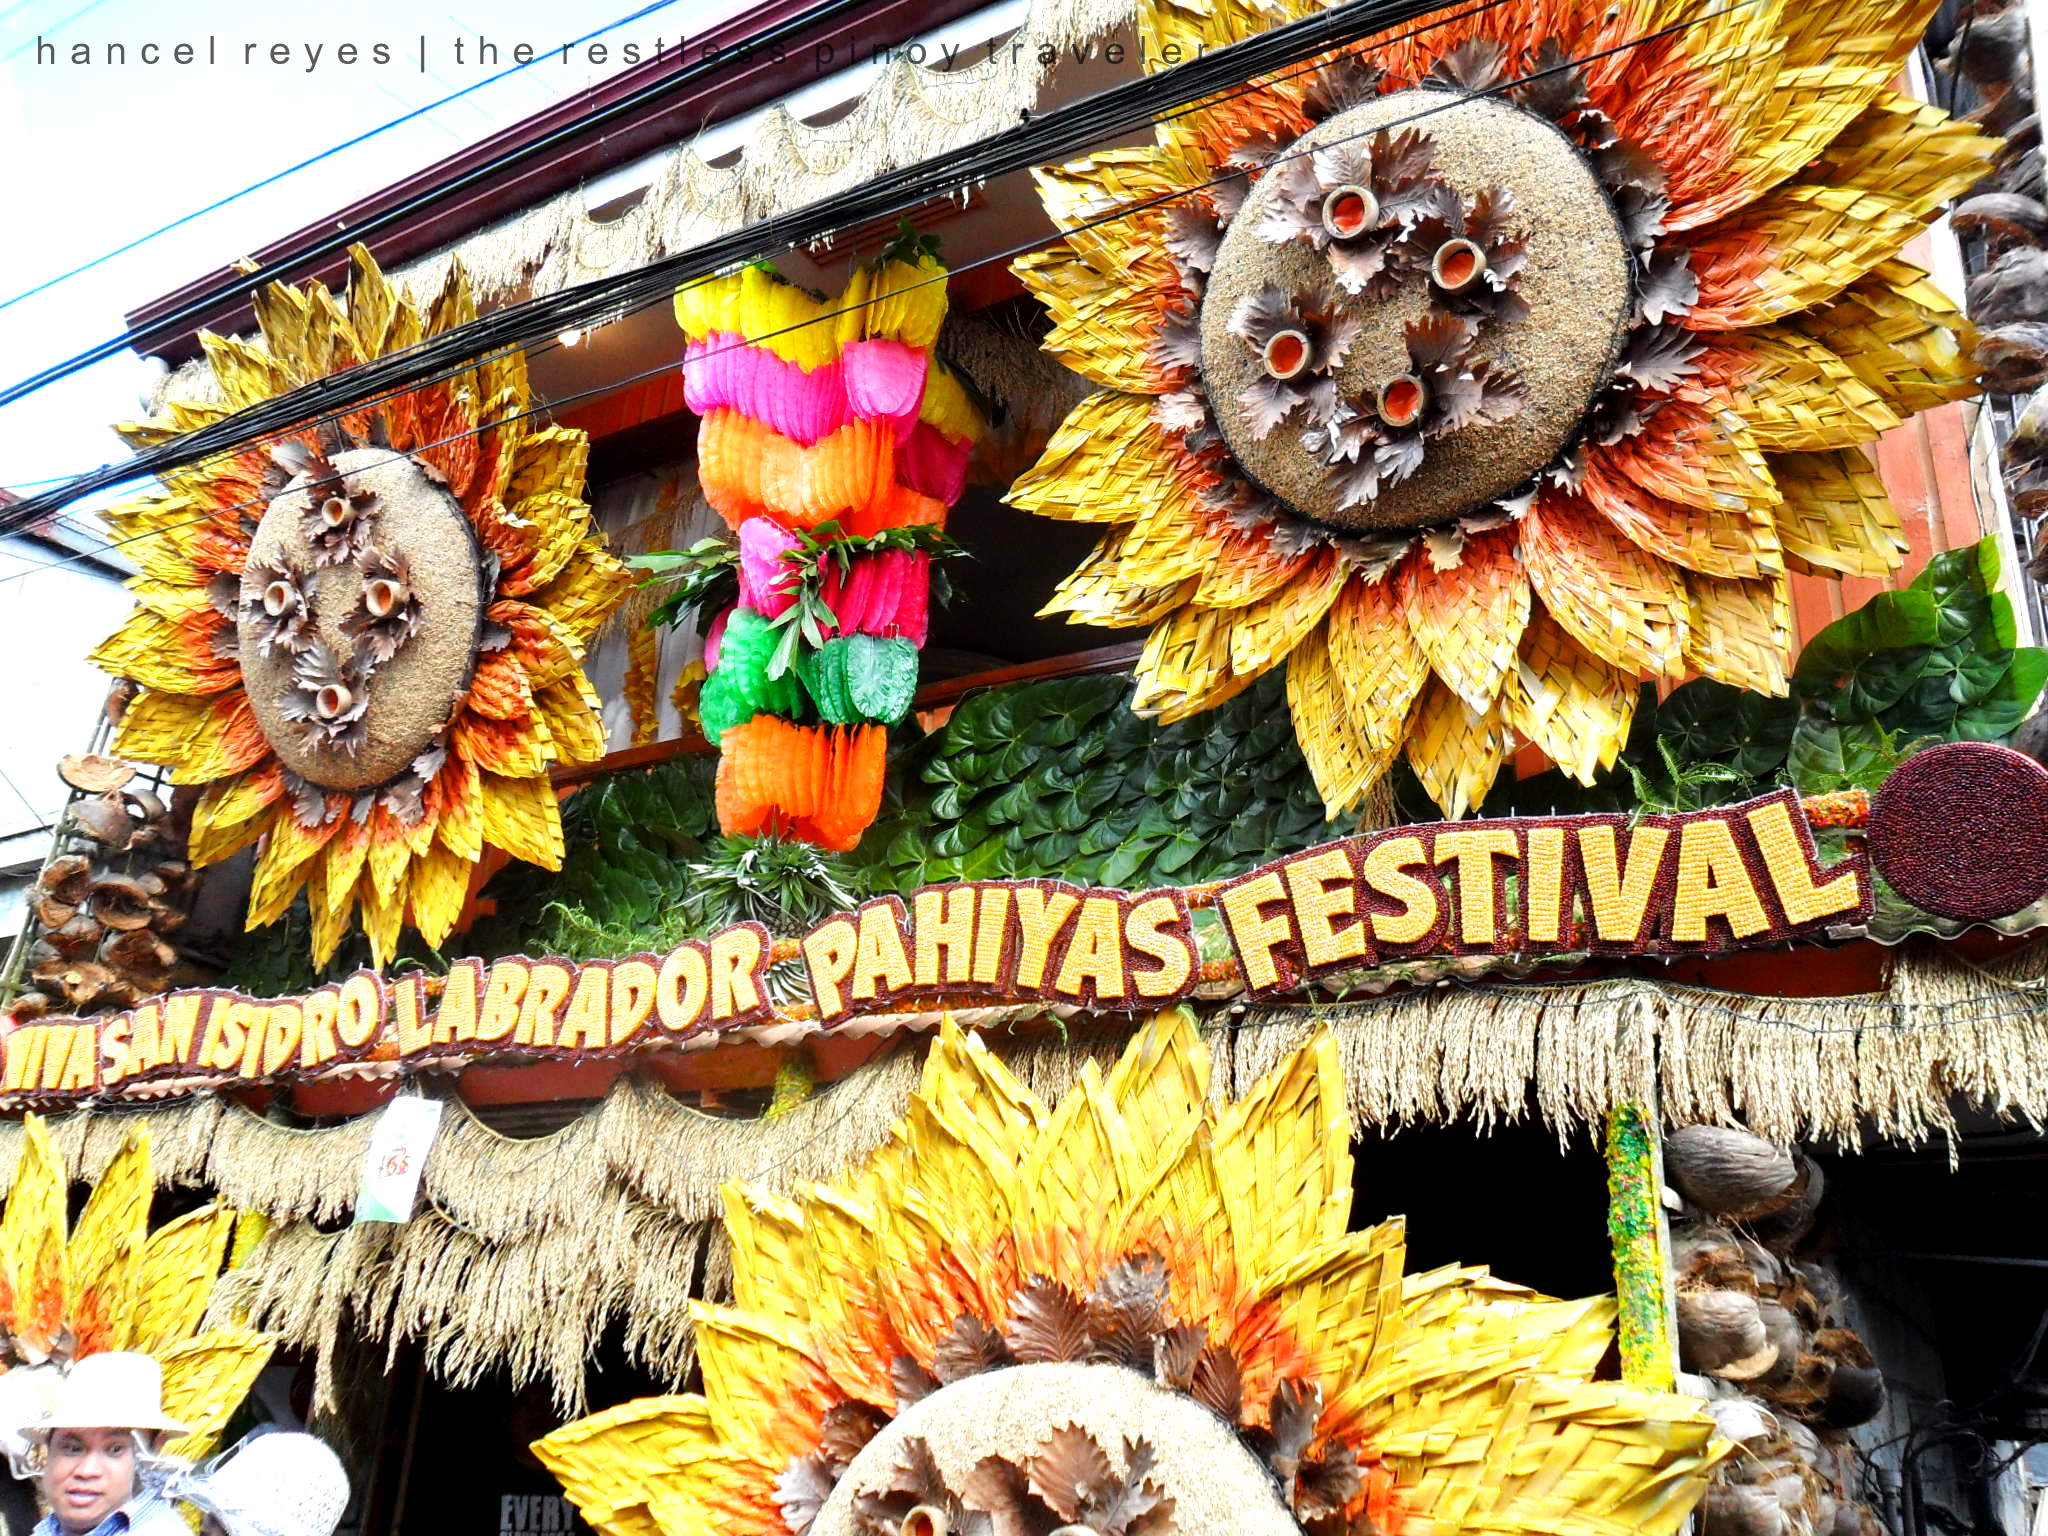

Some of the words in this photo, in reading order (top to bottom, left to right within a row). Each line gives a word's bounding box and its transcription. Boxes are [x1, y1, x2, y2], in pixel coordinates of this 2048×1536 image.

[101, 995, 201, 1085] SAN
[197, 976, 379, 1079] ISIDRO
[395, 929, 762, 1056] LABRADOR
[802, 887, 1191, 1019] PAHIYAS
[1221, 802, 1860, 992] FESTIVAL
[501, 1494, 575, 1531] EVERY
